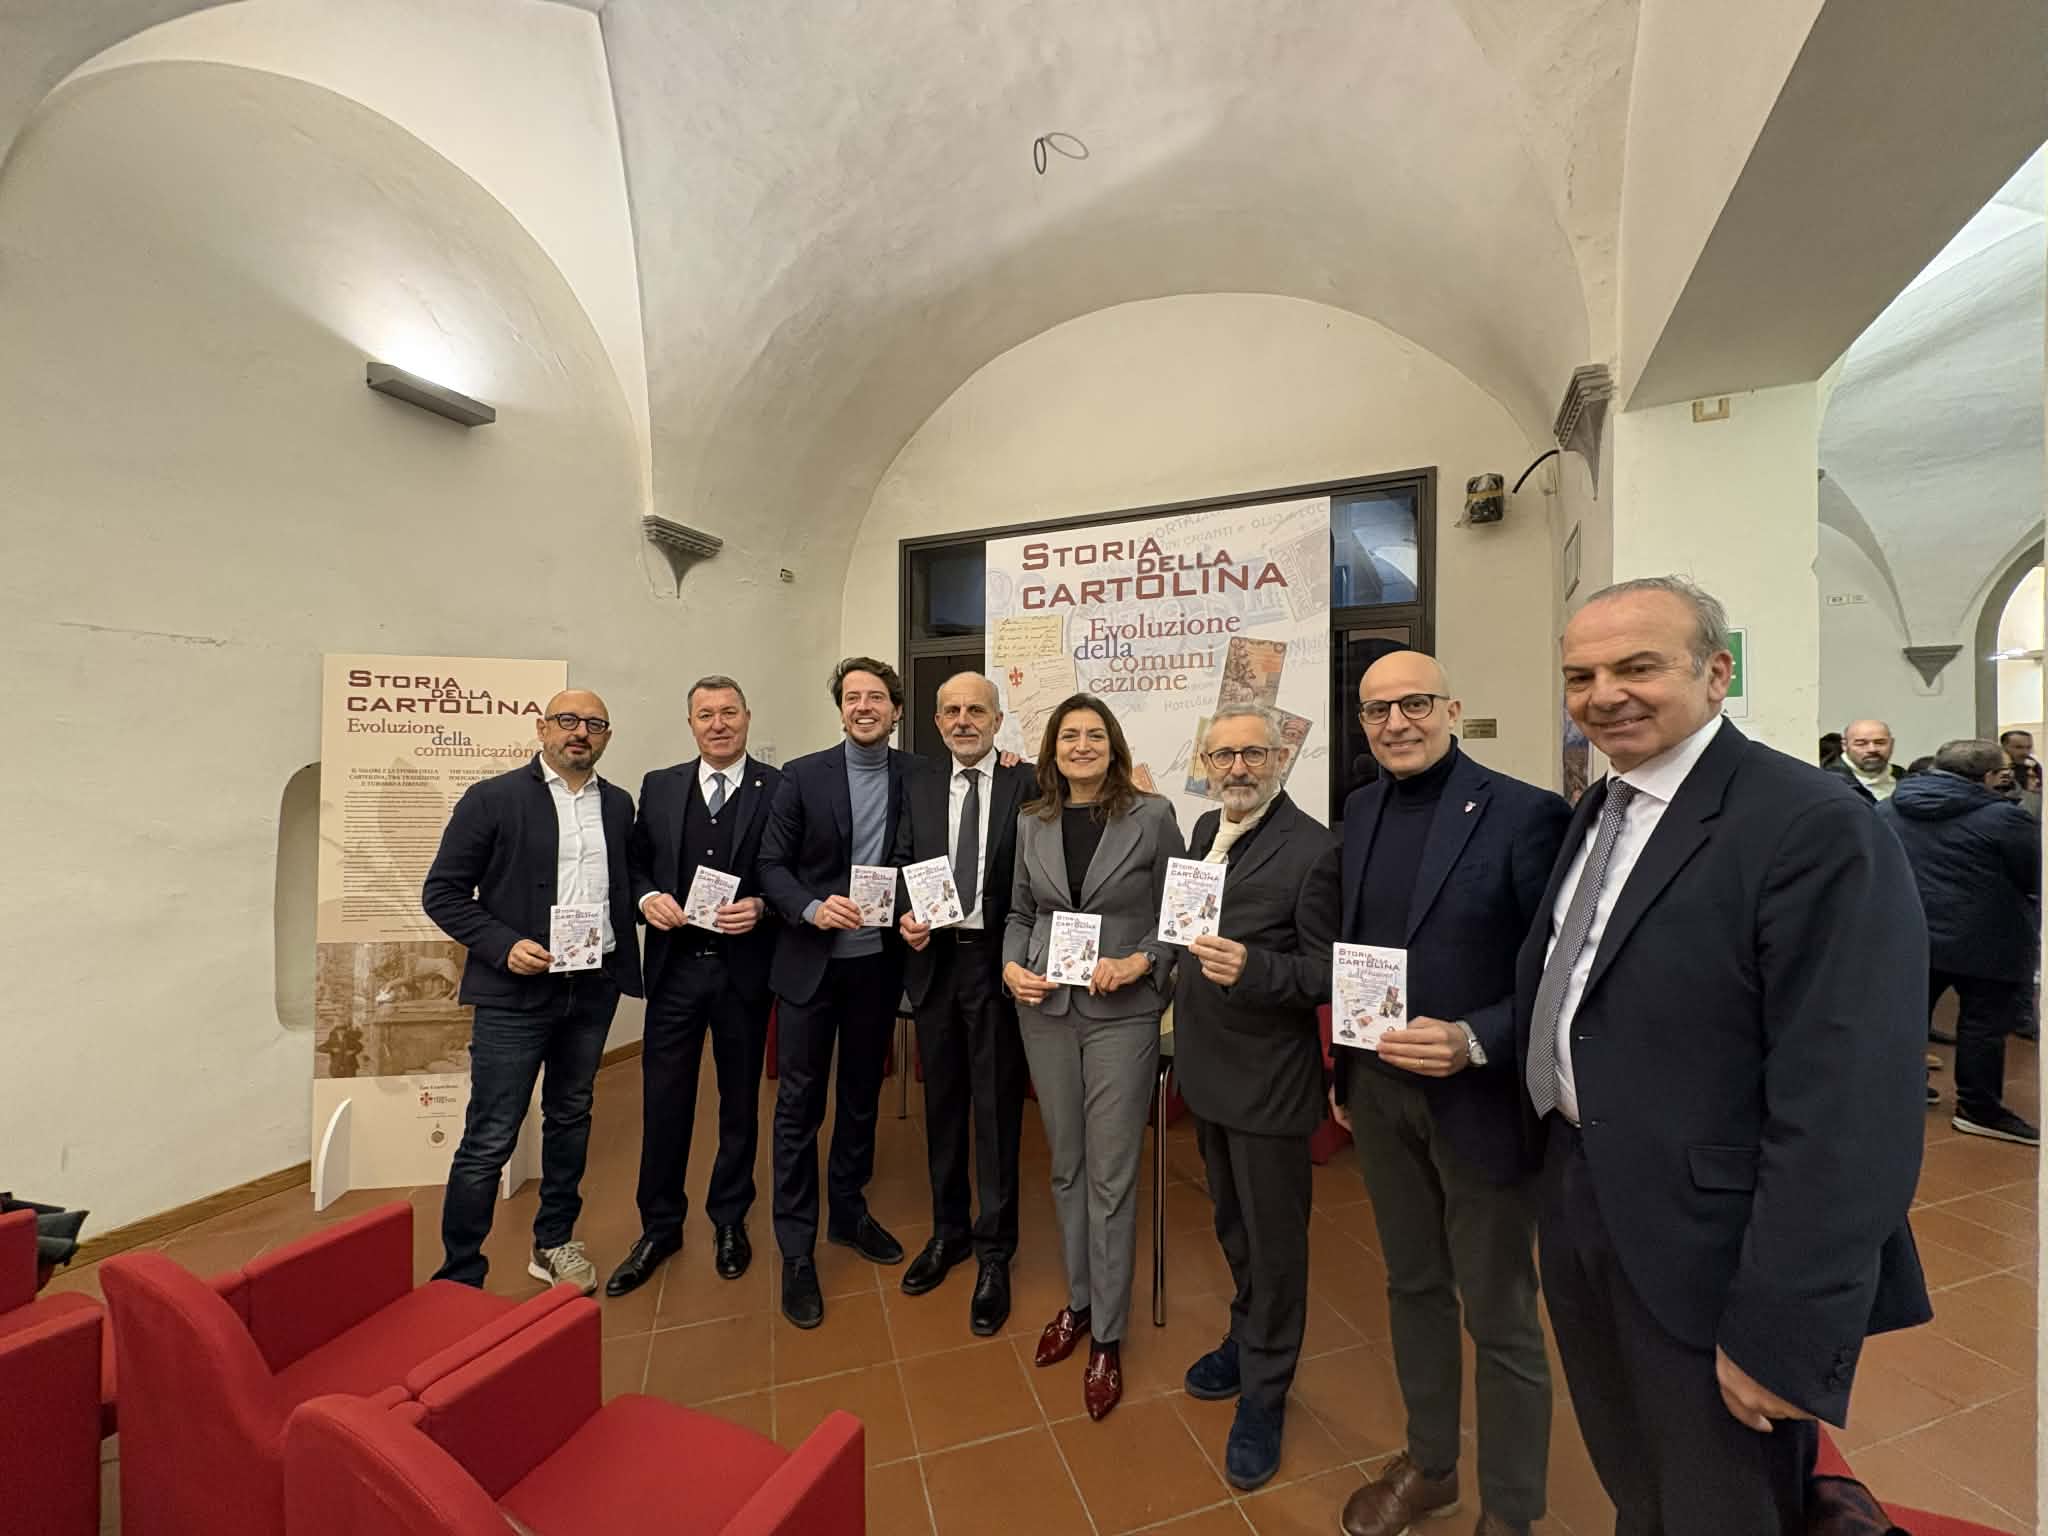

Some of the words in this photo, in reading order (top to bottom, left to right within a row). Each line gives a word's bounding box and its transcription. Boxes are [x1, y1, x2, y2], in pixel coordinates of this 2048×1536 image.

[1022, 537, 1162, 571] STORIA
[1137, 549, 1233, 575] DELLA
[1022, 562, 1289, 610] CARTOLINA
[1088, 612, 1241, 641] Evoluzione
[1073, 634, 1135, 661] della
[1108, 644, 1217, 673] comuni
[347, 670, 461, 690] STORIA
[1088, 670, 1188, 694] cazione
[346, 697, 543, 716] CARTOLINA
[431, 689, 492, 700] DELLA
[346, 717, 446, 735] Evoluzione
[431, 730, 473, 746] della
[1338, 957, 1401, 972] CARTOLINA
